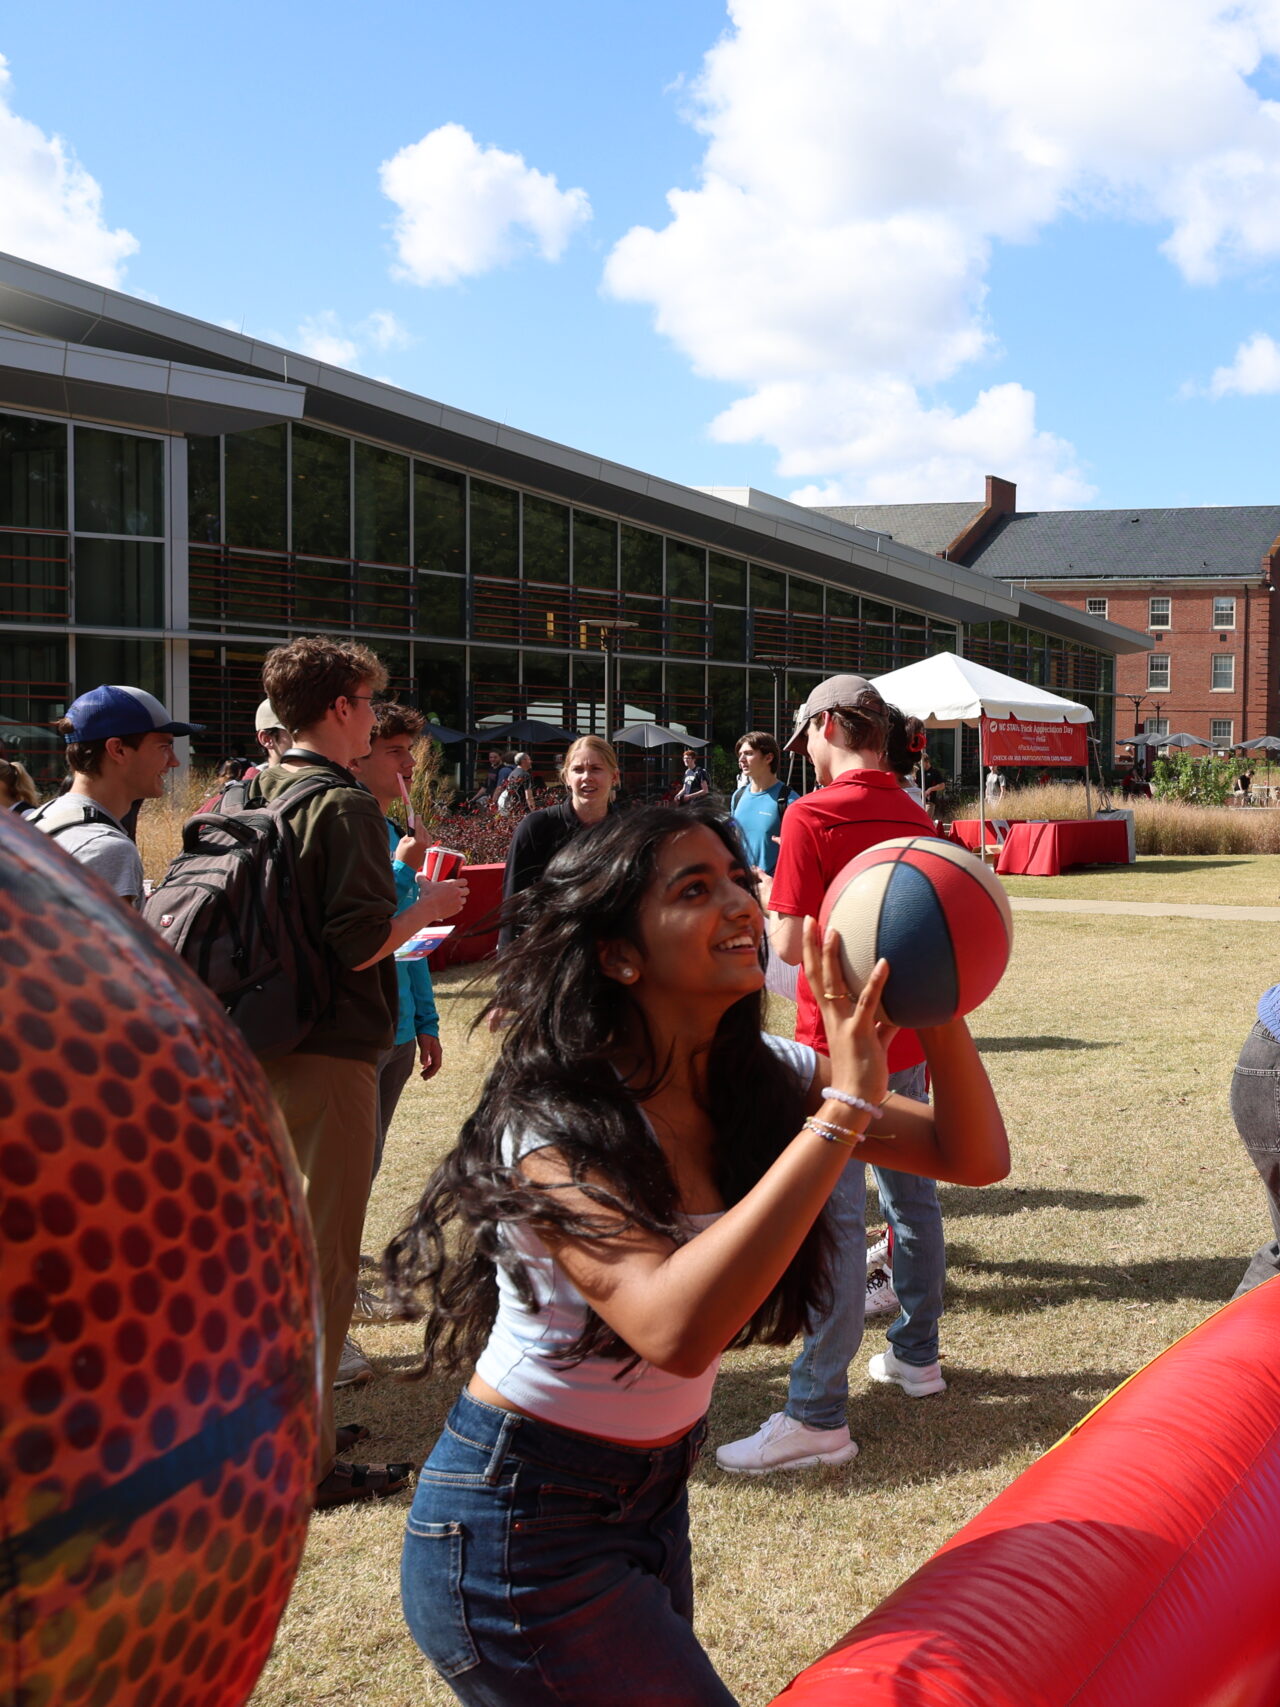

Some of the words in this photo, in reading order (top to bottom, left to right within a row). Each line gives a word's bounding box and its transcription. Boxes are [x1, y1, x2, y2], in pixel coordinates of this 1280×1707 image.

[1021, 724, 1033, 732] Pack
[1034, 726, 1062, 734] Appreciation
[1064, 726, 1073, 734] Day
